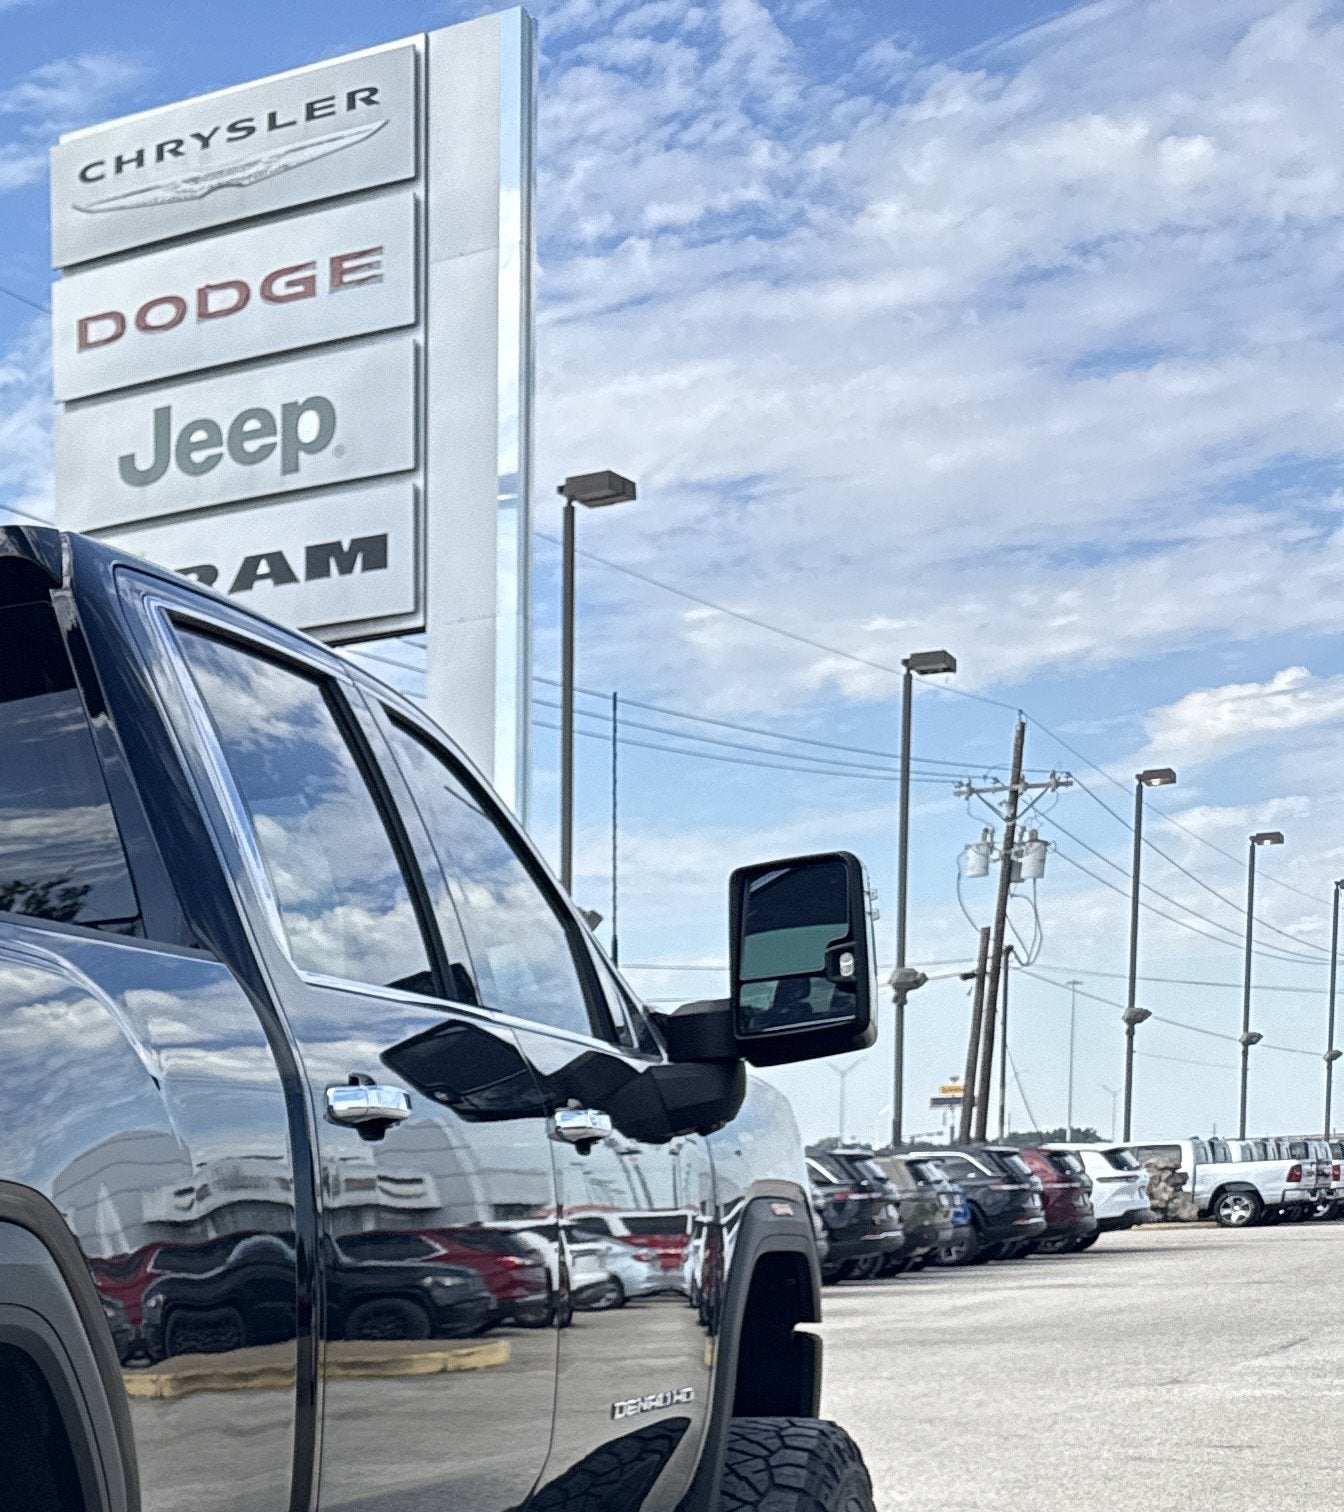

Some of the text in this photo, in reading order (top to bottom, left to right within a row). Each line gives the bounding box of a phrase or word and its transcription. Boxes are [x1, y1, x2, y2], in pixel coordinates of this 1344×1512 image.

[78, 85, 381, 185] CHRYSLER
[77, 246, 384, 353] DODGE
[118, 395, 337, 487] Jeep
